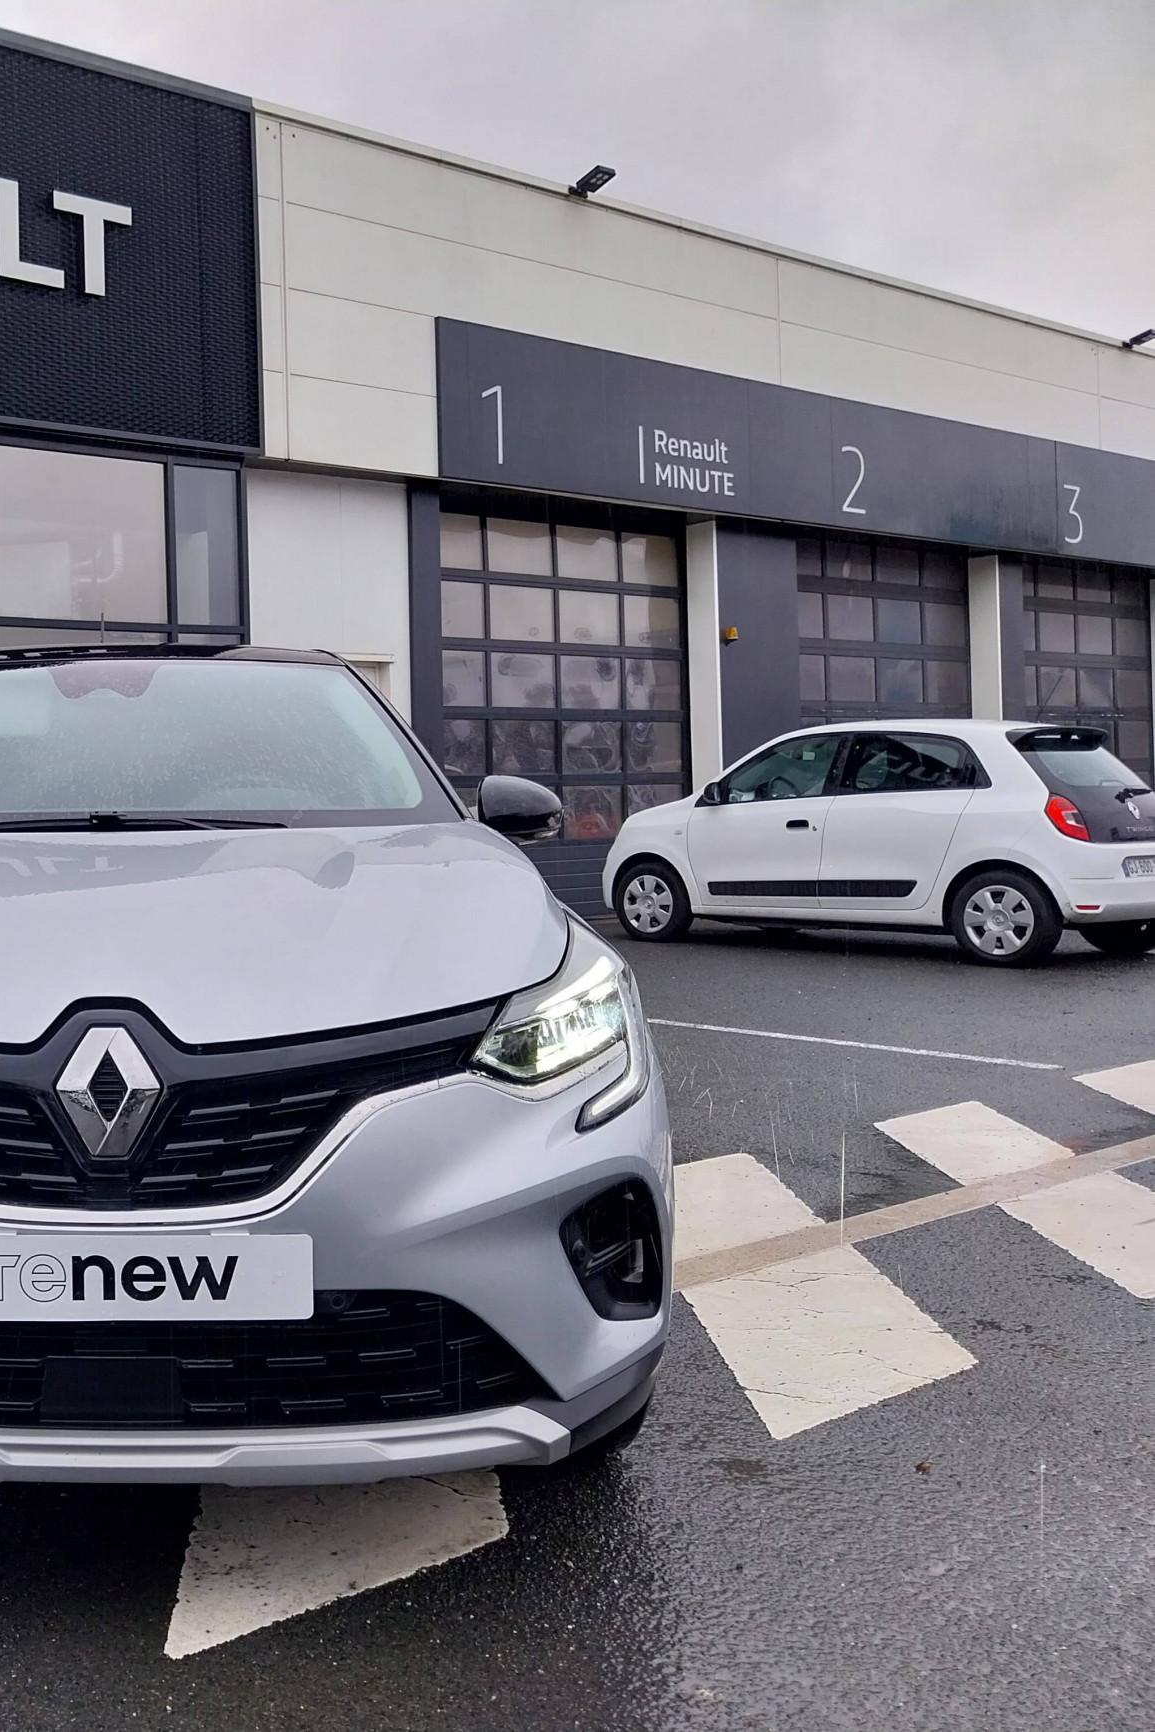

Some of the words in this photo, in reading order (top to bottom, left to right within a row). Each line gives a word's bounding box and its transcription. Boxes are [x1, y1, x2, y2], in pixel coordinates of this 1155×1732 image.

[481, 384, 504, 465] 1
[654, 429, 729, 464] Renault
[655, 462, 735, 497] MINUTE
[841, 446, 866, 515] 2
[1063, 484, 1083, 544] 3
